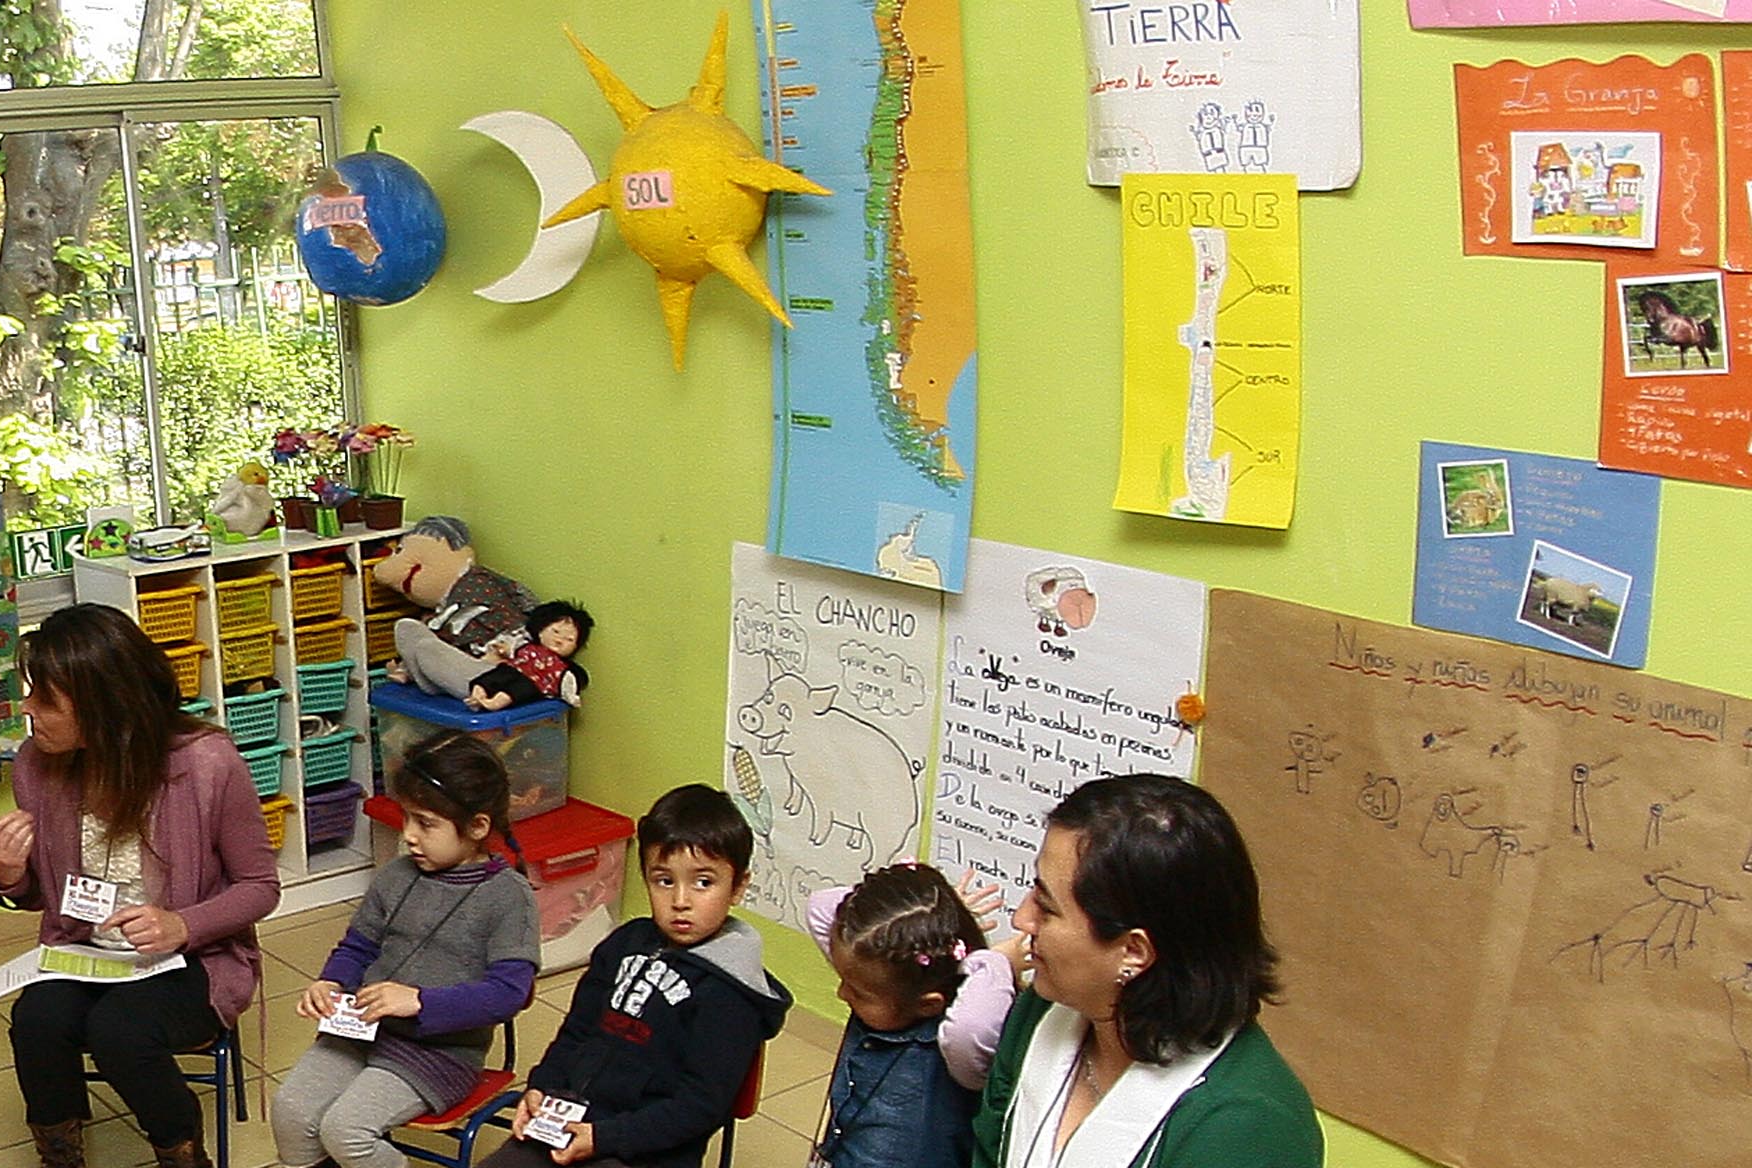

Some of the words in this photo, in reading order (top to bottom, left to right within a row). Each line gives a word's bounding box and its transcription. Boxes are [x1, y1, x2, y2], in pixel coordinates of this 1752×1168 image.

[1503, 73, 1550, 109] La
[1564, 74, 1659, 115] Granja
[626, 176, 669, 206] SOL
[1131, 191, 1279, 229] CHILE
[1245, 374, 1289, 386] CENTRO
[777, 581, 801, 615] EL
[816, 595, 916, 637] CHANCHO
[1026, 677, 1039, 689] es
[1044, 682, 1062, 696] un
[945, 720, 953, 736] y
[1031, 744, 1052, 764] por
